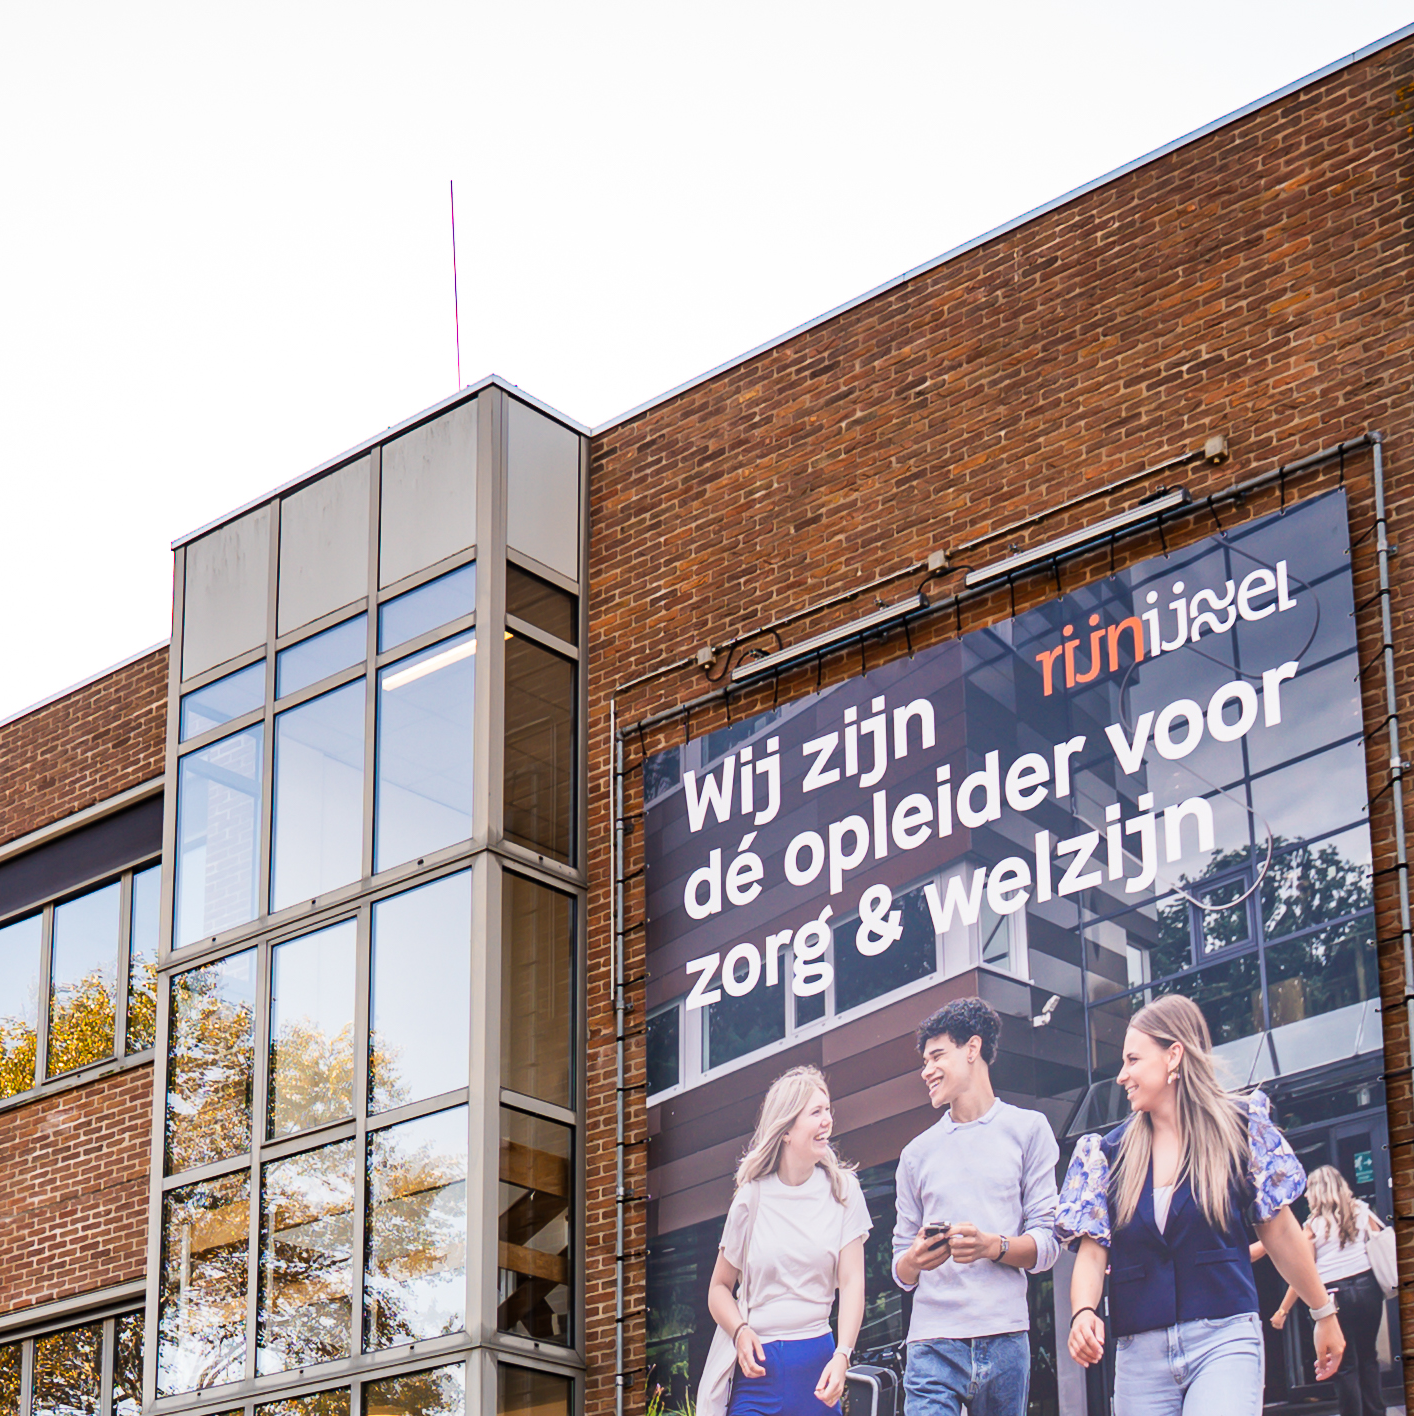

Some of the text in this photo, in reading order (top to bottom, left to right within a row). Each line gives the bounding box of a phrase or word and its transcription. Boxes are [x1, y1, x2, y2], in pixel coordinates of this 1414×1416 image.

[682, 694, 937, 834] Wij zijn
[683, 660, 1300, 921] dé opleider voor
[685, 790, 1218, 1012] zorg & welzijn
